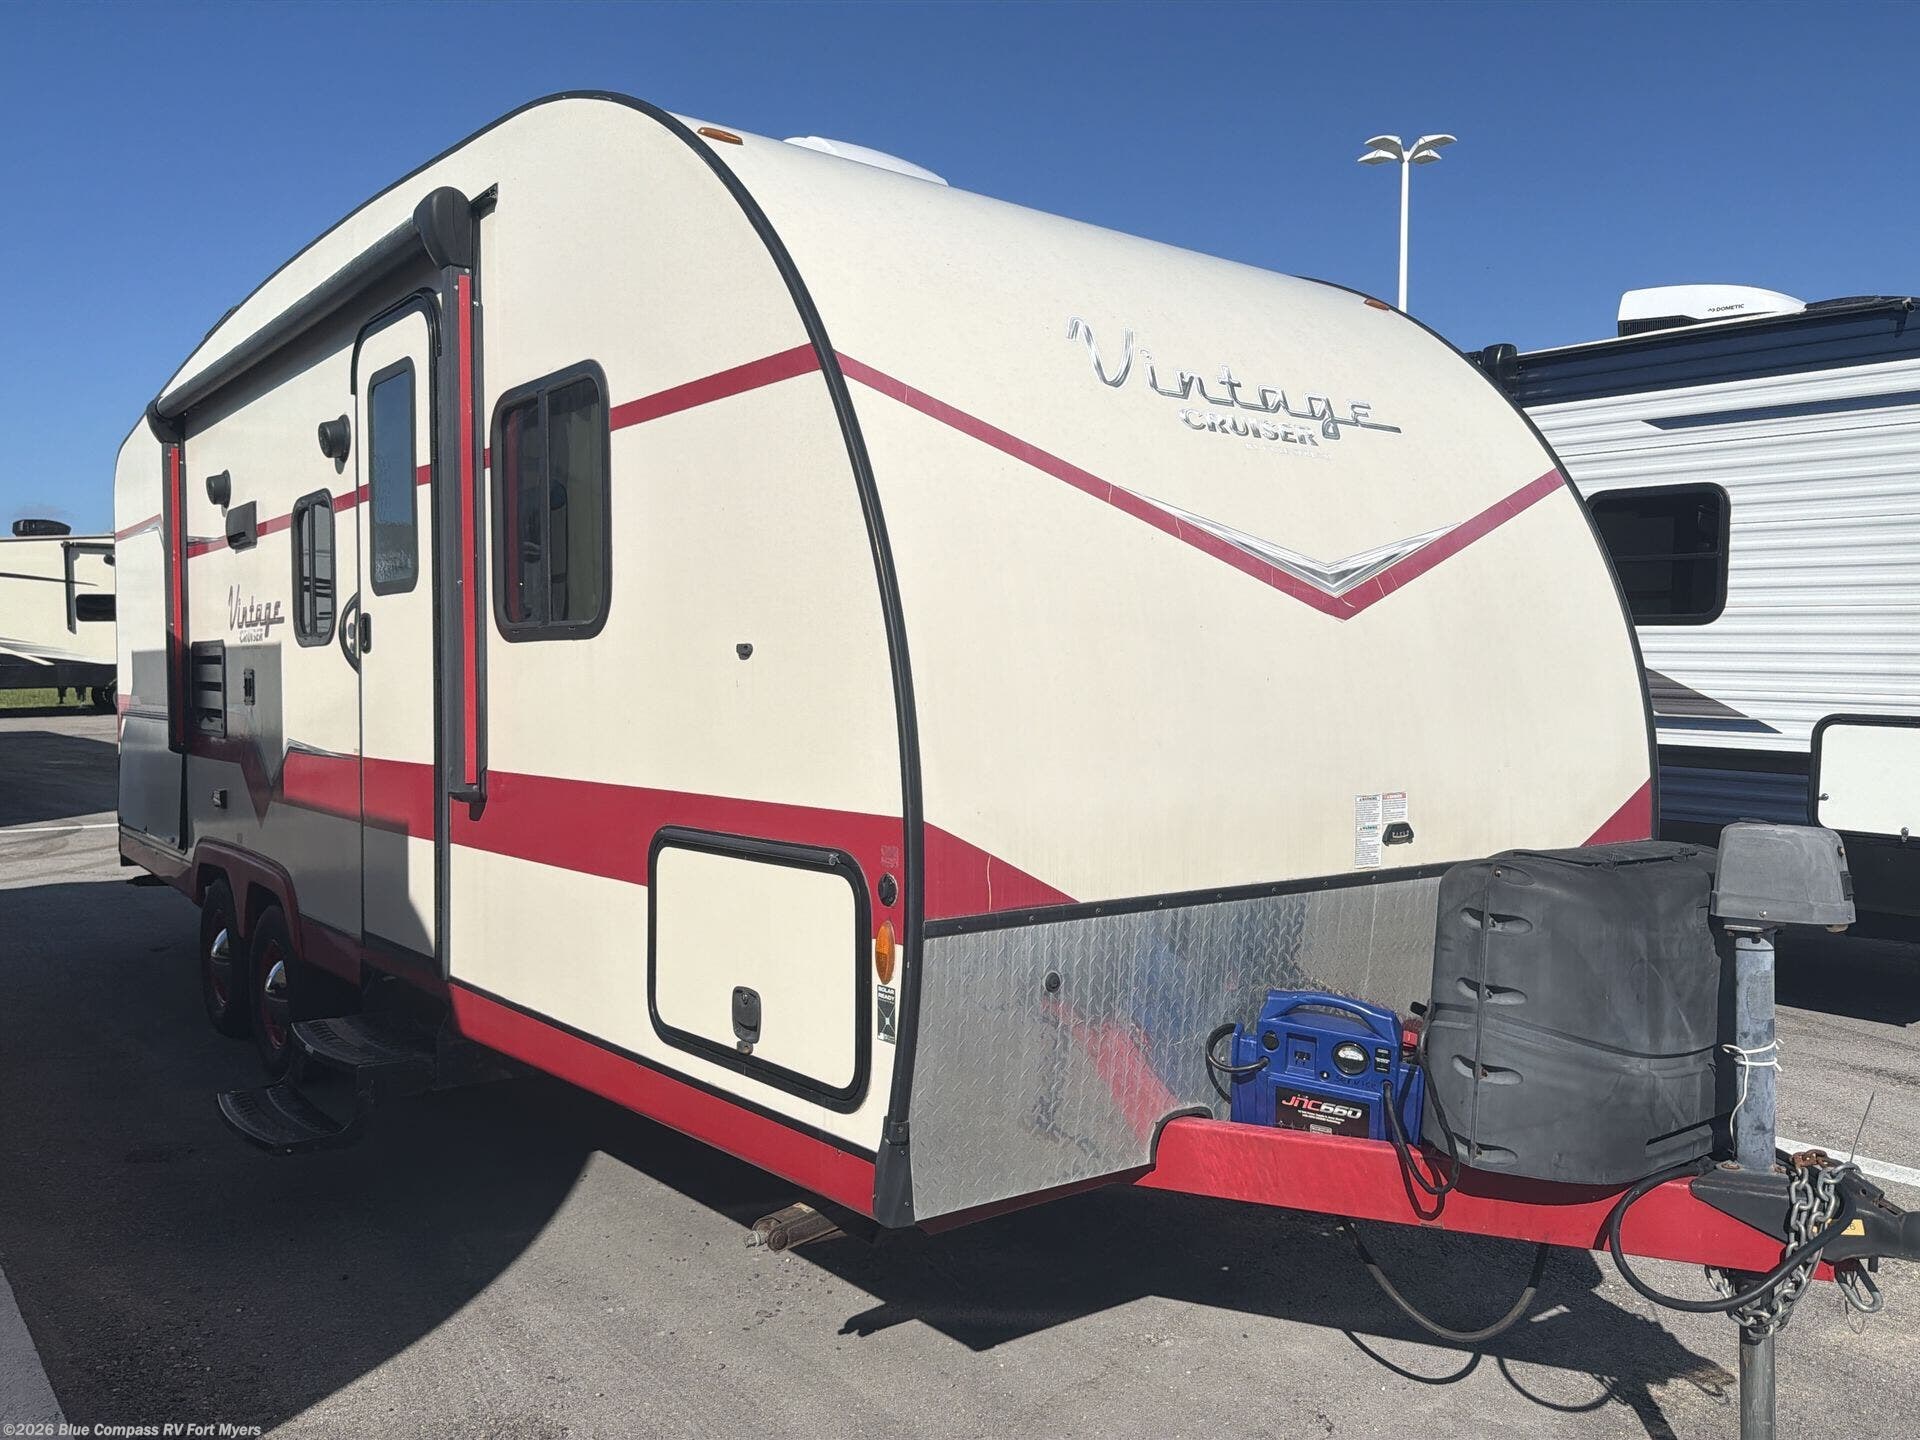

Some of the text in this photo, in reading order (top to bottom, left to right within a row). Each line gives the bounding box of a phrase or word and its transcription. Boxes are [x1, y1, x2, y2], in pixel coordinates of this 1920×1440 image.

[1716, 304, 1744, 312] DOMETIC
[1066, 316, 1402, 441] Vintage
[1179, 408, 1319, 447] CRUISER
[228, 584, 285, 638] Vintage
